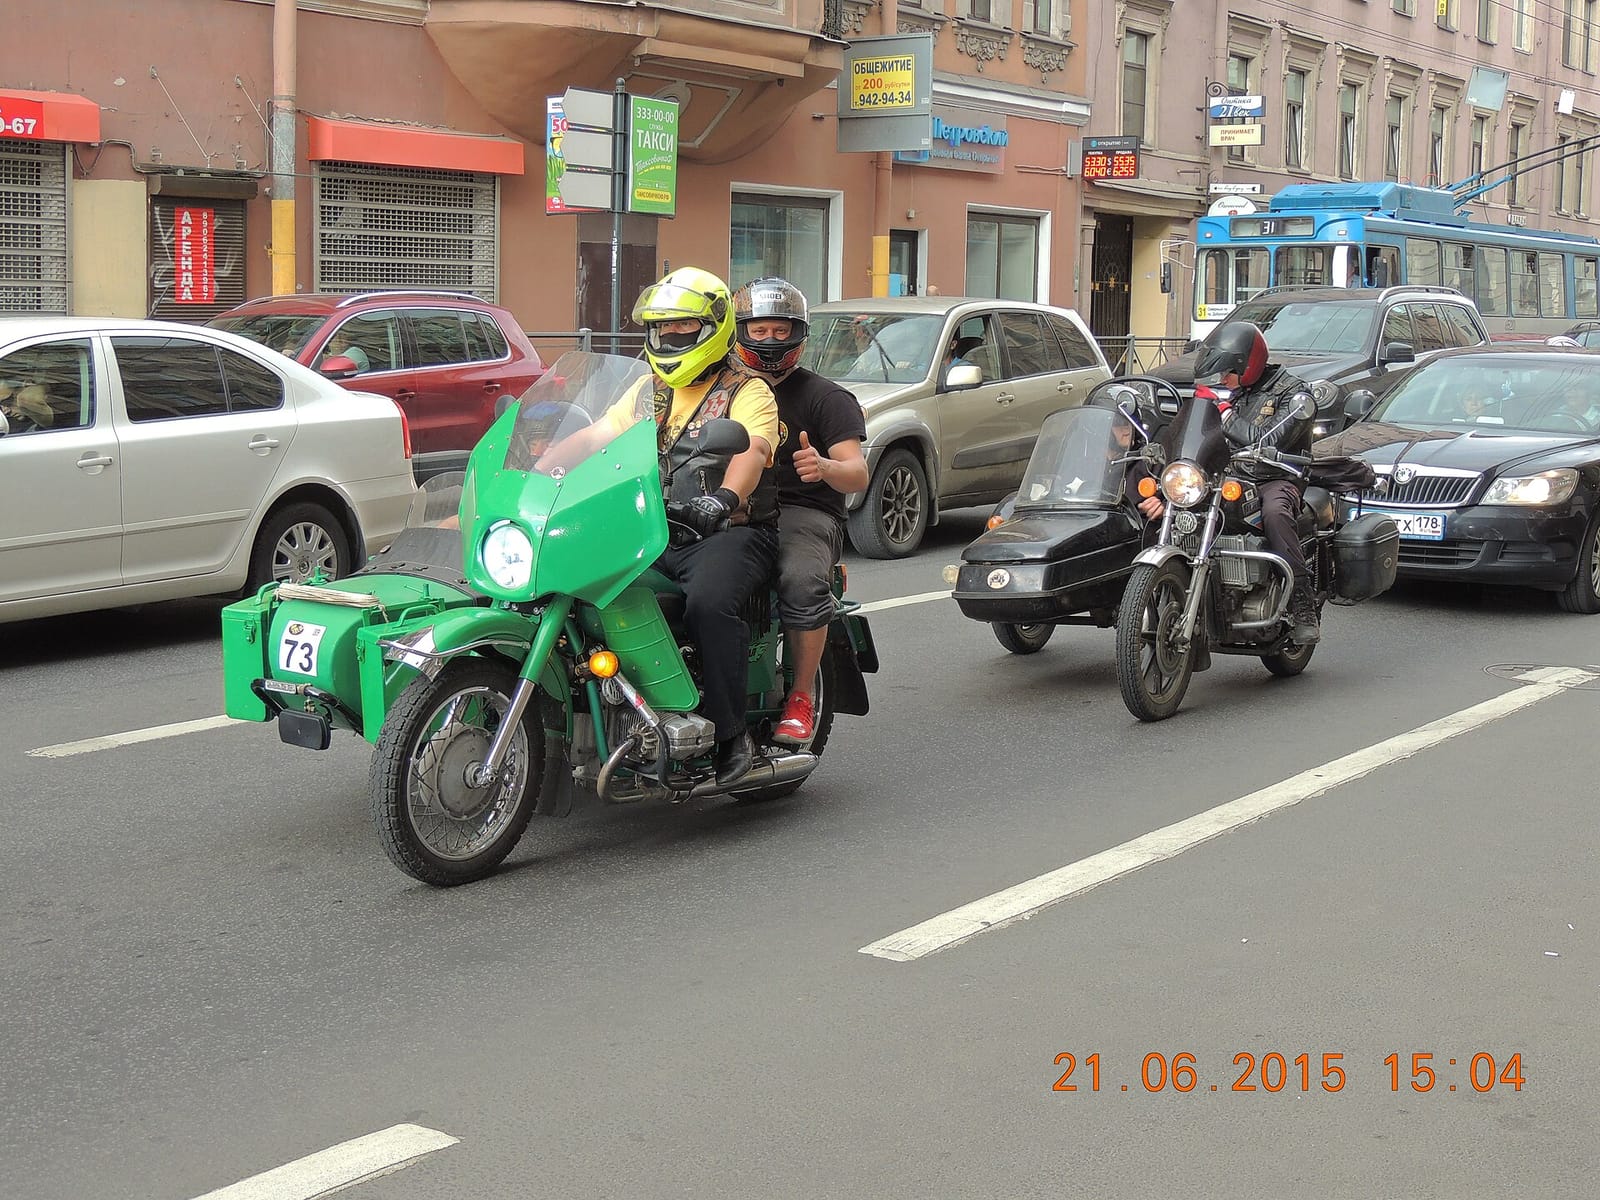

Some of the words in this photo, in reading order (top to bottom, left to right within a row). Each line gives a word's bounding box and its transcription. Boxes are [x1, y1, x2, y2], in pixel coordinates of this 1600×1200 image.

[854, 59, 912, 75] ОБЩЕЖИТИЕ
[863, 77, 883, 90] 200
[636, 106, 674, 124] 333-00-00
[636, 129, 674, 152] ТАКСИ
[1262, 221, 1275, 235] 31
[181, 211, 194, 300] АРЕНДА
[1198, 307, 1206, 317] 31
[1415, 516, 1438, 529] 178
[284, 638, 313, 672] 73
